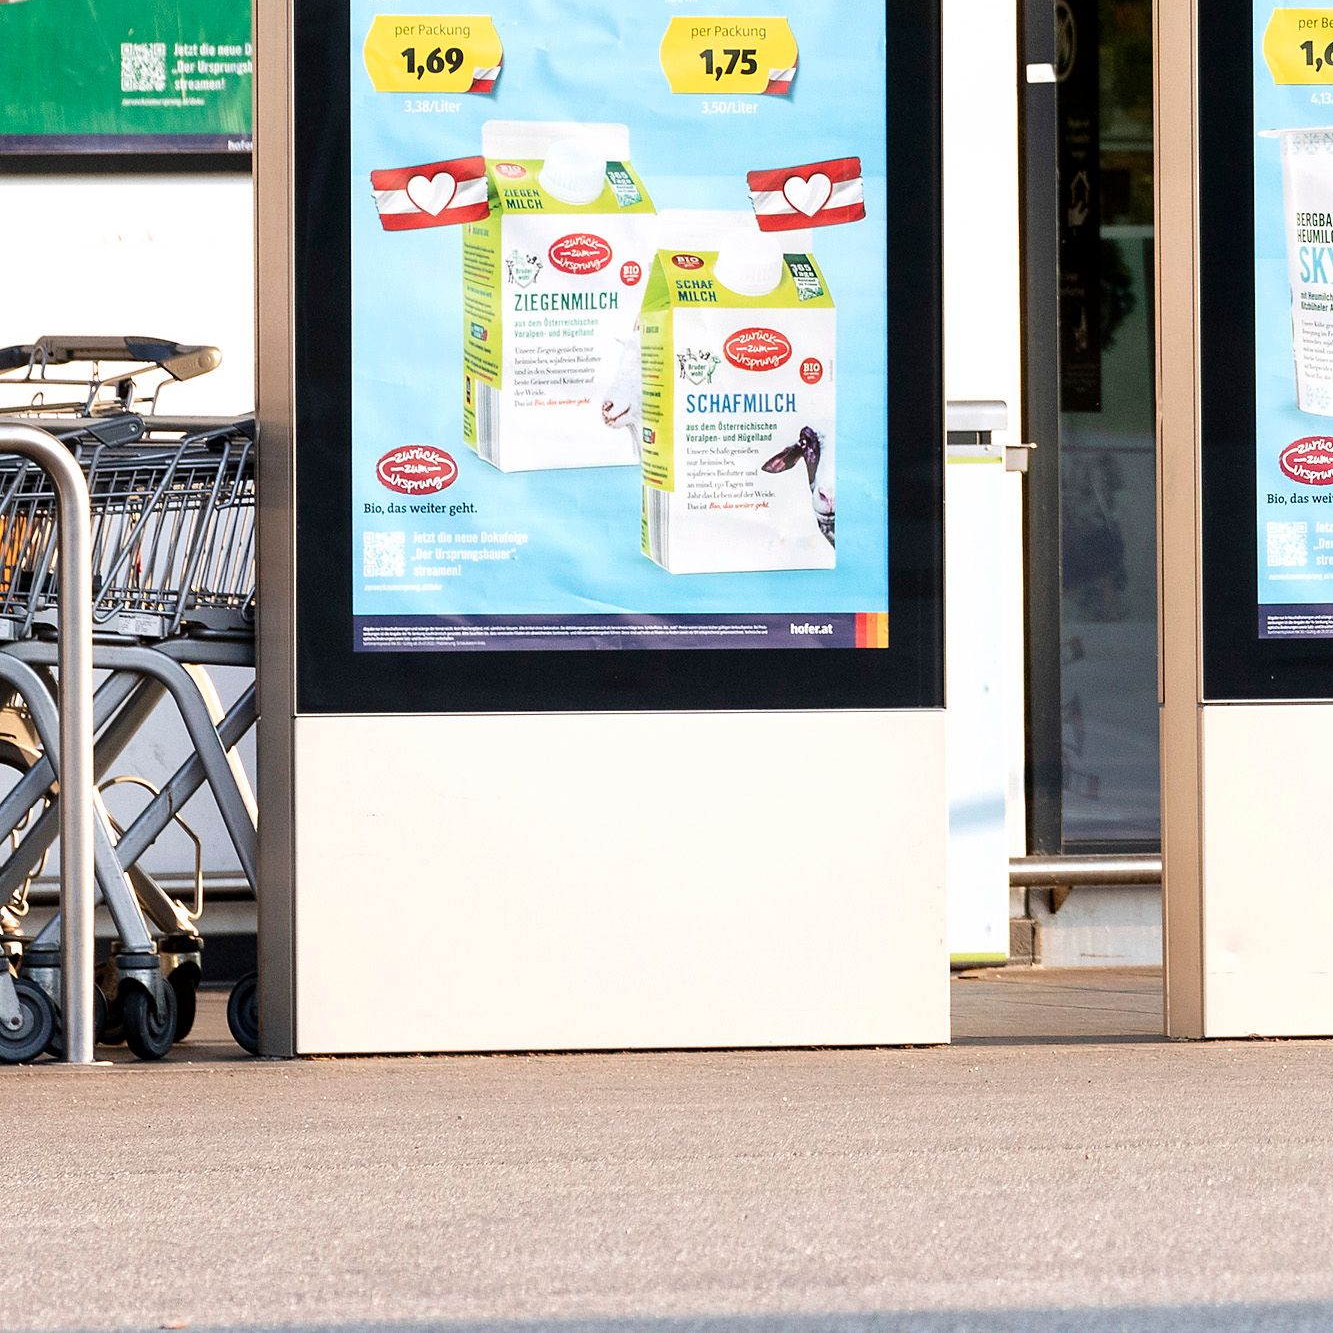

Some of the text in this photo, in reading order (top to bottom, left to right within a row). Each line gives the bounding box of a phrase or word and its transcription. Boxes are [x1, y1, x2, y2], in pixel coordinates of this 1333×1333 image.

[1298, 19, 1318, 30] per
[395, 24, 471, 39] per Packung
[691, 26, 767, 40] per Packung
[173, 43, 243, 57] Jetzt die neue
[401, 47, 464, 80] 1,69
[699, 49, 758, 82] 1,75
[174, 77, 225, 91] streamen!
[404, 100, 462, 114] 3,38/Liter
[701, 101, 759, 115] 3,50/Liter
[228, 138, 252, 151] hofe
[504, 189, 540, 197] ZIEGEN
[506, 199, 543, 209] MILCH
[563, 236, 599, 249] zurück
[559, 258, 600, 274] Ursprung
[623, 265, 640, 275] BIO
[675, 279, 714, 289] SCHAF
[514, 292, 619, 312] ZIEGENMILCH
[678, 290, 717, 302] MILCH
[528, 319, 542, 327] dem
[544, 317, 599, 327] Österreichischen
[739, 330, 778, 345] zurück
[735, 354, 780, 370] Ursprung
[803, 362, 820, 372] BIO
[686, 393, 797, 414] SCHAFMILCH
[701, 423, 716, 431] dem
[718, 421, 778, 431] Österreichischen
[686, 432, 772, 443] Voralpen- und Hügelland
[395, 448, 440, 464] zurück
[1306, 455, 1331, 464] zum
[403, 464, 429, 474] zum
[390, 474, 444, 493] Ursprung
[1267, 494, 1287, 505] Bio,
[1290, 494, 1309, 504] das
[364, 503, 478, 516] Bio, das weiter geht.
[790, 623, 833, 635] hofer.at
